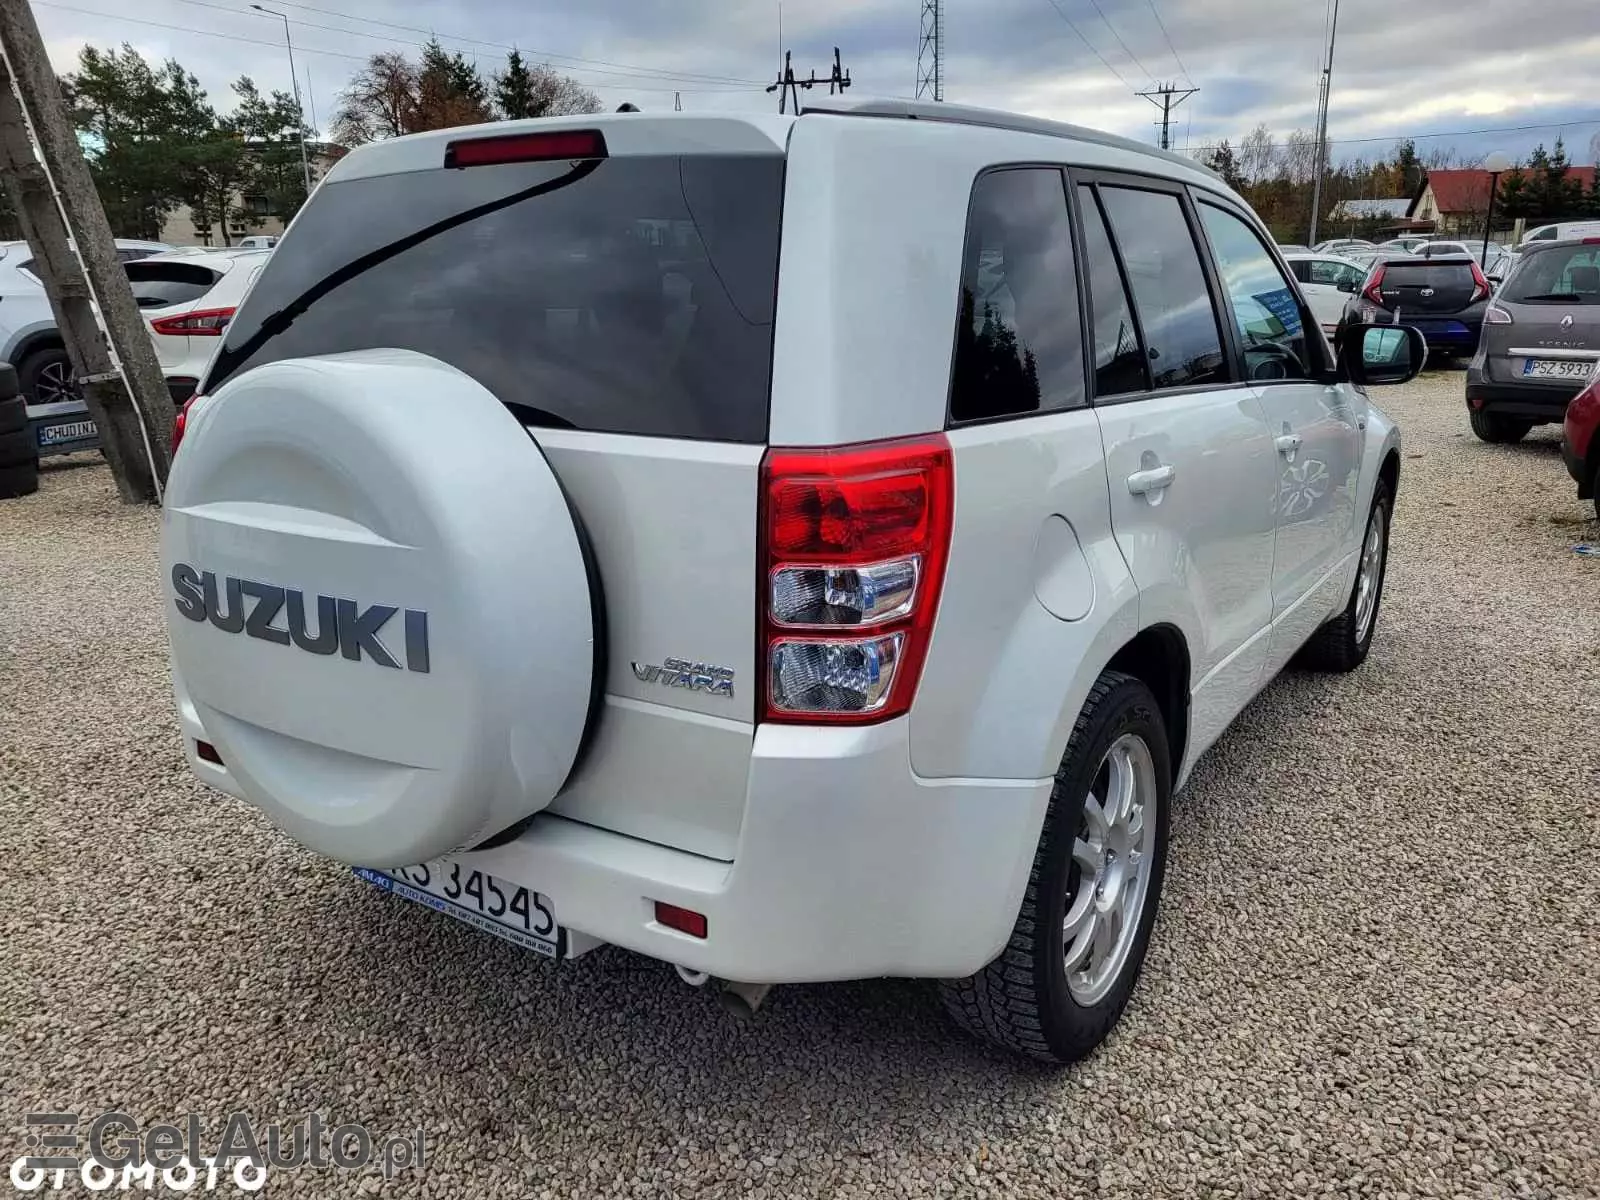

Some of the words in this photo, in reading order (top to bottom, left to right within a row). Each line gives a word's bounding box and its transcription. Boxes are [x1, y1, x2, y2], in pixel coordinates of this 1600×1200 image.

[1532, 361, 1555, 375] PSZ
[171, 561, 431, 674] SUZUKI
[631, 661, 735, 698] VITARA
[443, 862, 554, 936] 34545
